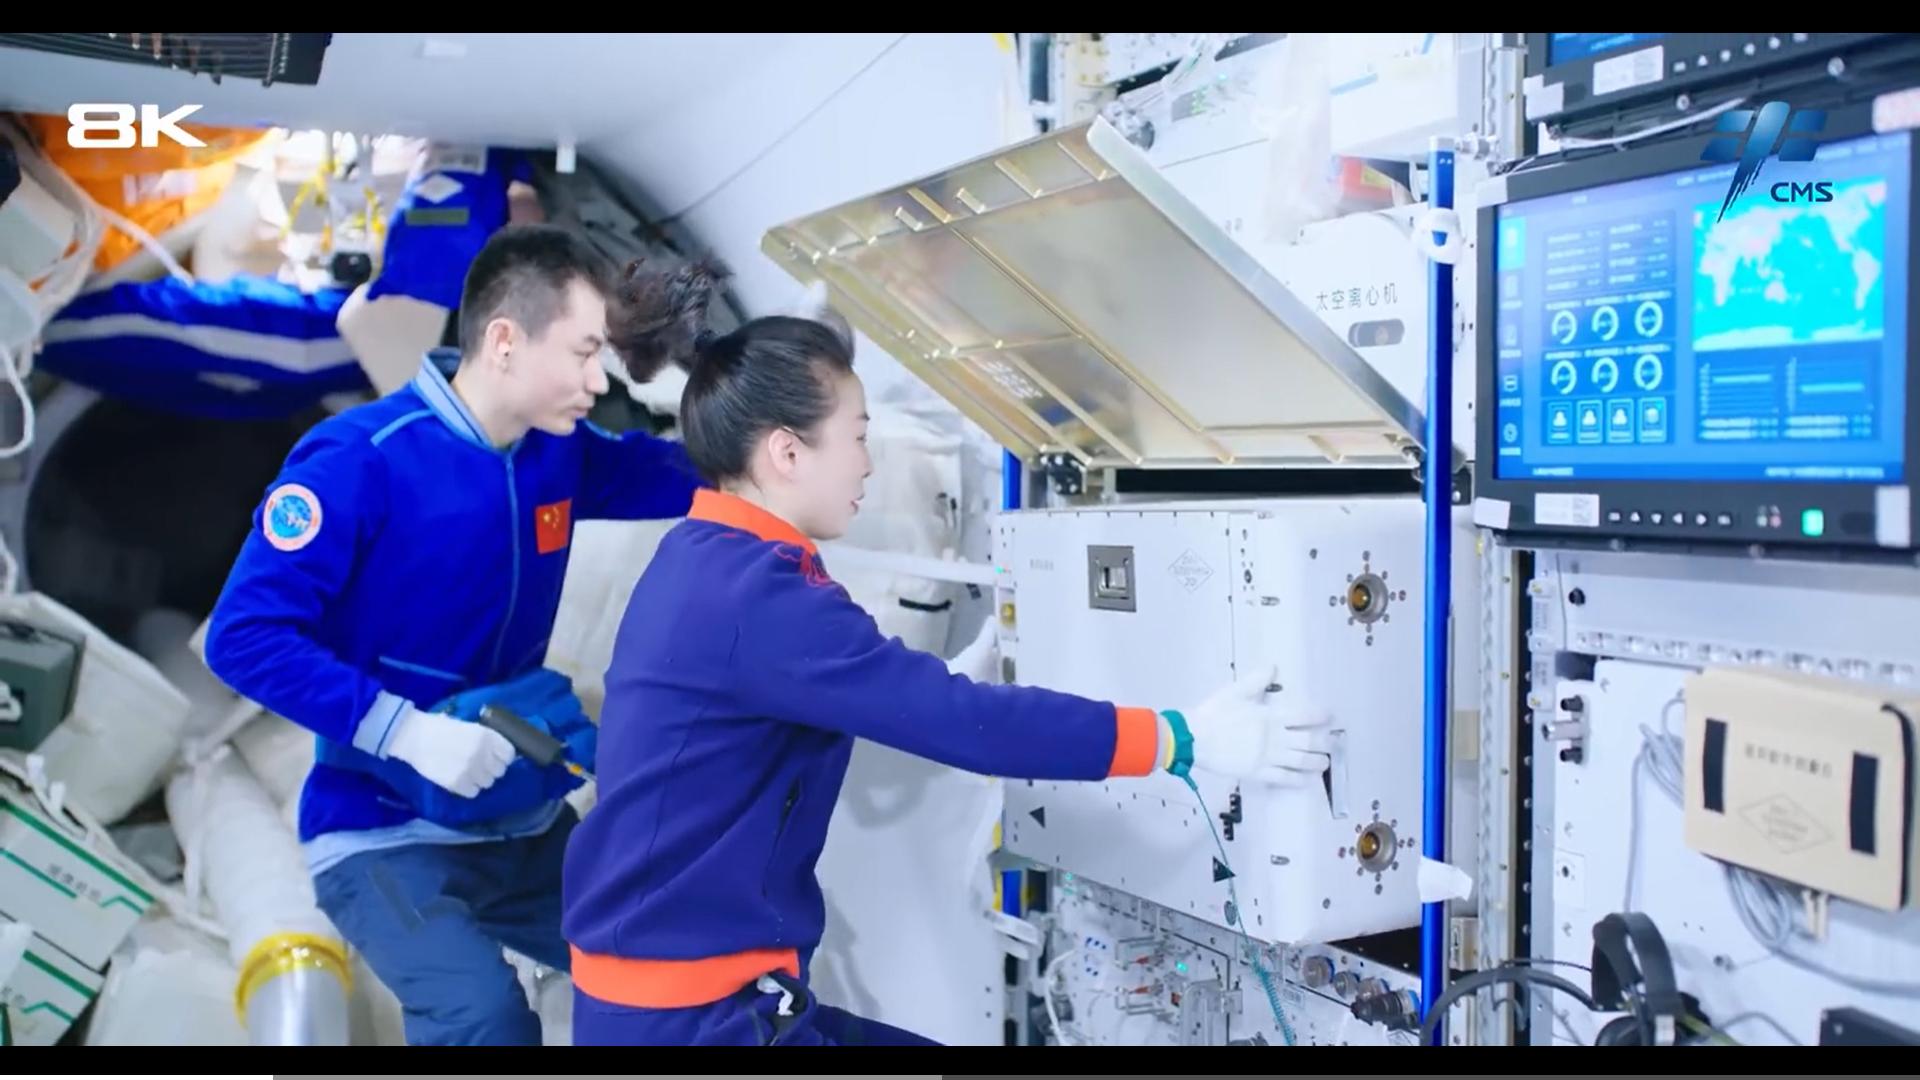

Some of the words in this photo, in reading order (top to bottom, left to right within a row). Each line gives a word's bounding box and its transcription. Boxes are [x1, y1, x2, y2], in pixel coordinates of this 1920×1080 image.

[1315, 282, 1398, 311] 太空离心机
